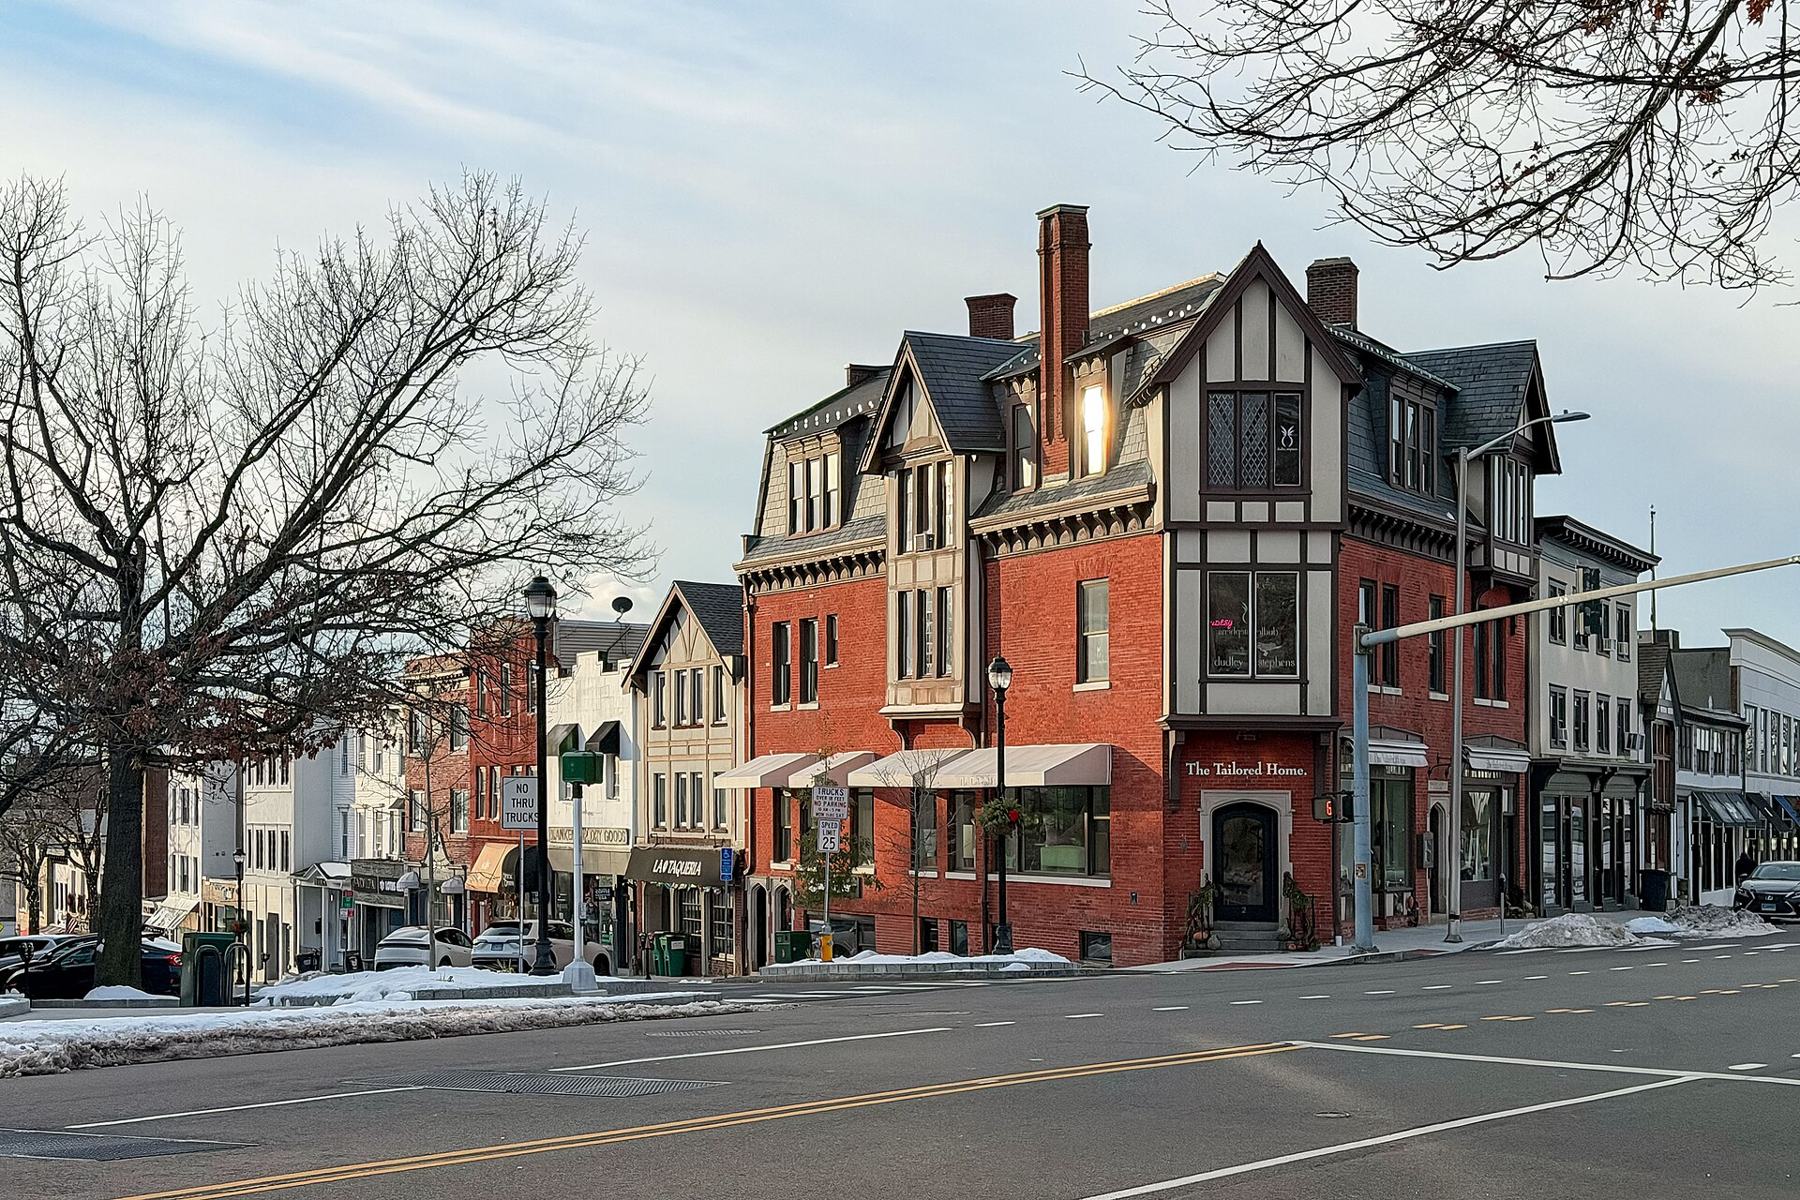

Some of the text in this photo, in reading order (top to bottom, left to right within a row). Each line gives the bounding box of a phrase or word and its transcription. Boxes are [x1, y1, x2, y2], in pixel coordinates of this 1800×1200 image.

[1214, 656, 1296, 670] dudley stephens
[1186, 762, 1307, 776] The Tailored Home.
[516, 784, 528, 794] NO
[818, 788, 844, 796] TRUCKS
[512, 798, 534, 808] THRU
[1326, 801, 1332, 816] 6
[505, 812, 539, 823] TRUCKS
[604, 830, 626, 842] GOODS
[823, 837, 835, 850] 25
[653, 860, 663, 873] LA
[668, 860, 702, 877] TAQUERIA
